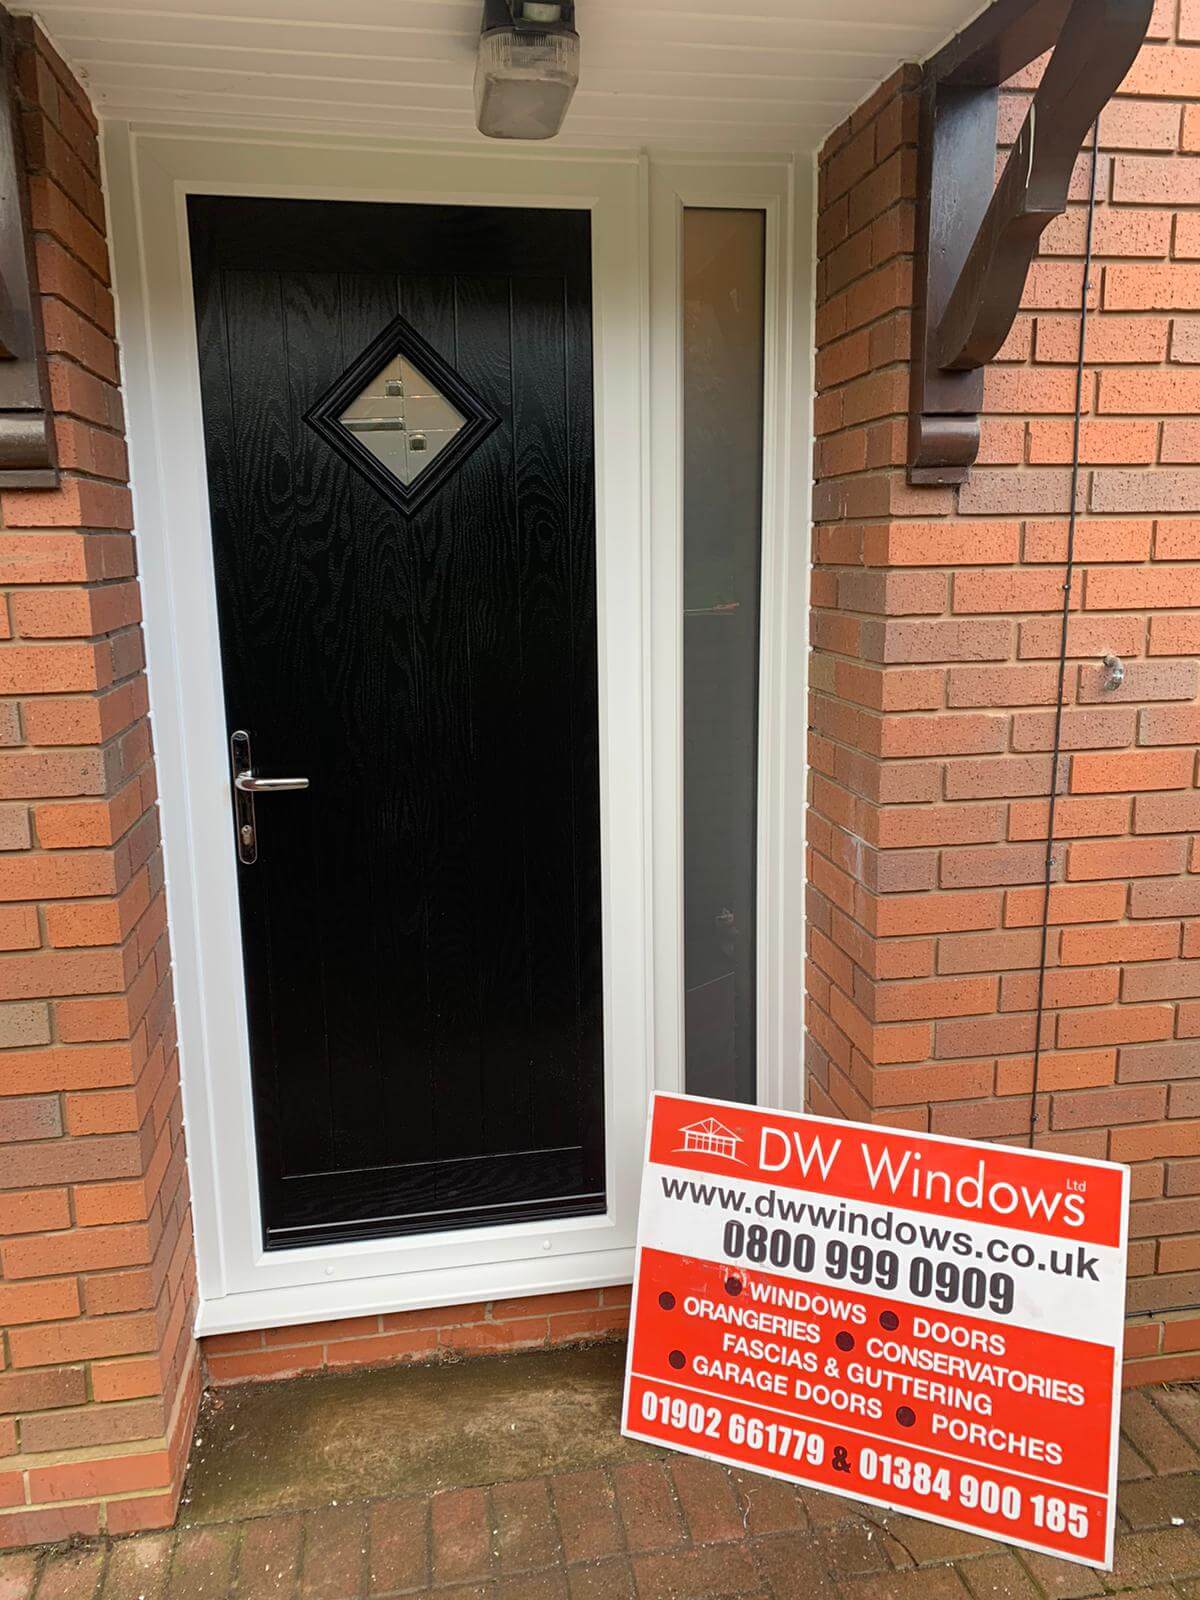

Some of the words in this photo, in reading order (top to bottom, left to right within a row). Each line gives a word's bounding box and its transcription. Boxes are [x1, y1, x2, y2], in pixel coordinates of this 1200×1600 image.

[758, 1126, 841, 1182] DW
[862, 1141, 1086, 1227] Windows
[1066, 1178, 1087, 1193] Ltd
[661, 1176, 1100, 1282] www.dwwindows.co.uk
[723, 1219, 814, 1273] 0800
[825, 1239, 899, 1290] 999
[909, 1256, 1015, 1315] 0909
[683, 1297, 820, 1344] ORANGERIES
[866, 1338, 1085, 1406] CONSERVATORIES
[749, 1282, 867, 1324] WINDOWS
[913, 1317, 1006, 1355] DOORS
[693, 1356, 788, 1396] GARAGE
[795, 1380, 883, 1419] DOORS
[932, 1416, 1063, 1465] PORCHES
[723, 1334, 818, 1372] FASCIAS
[825, 1358, 839, 1378] &
[847, 1363, 993, 1416] GUTTERING
[641, 1391, 720, 1439] 01902
[729, 1414, 825, 1466] 661779
[832, 1446, 852, 1473] &
[859, 1448, 951, 1502] 01384
[959, 1475, 1021, 1521] 900
[1030, 1495, 1089, 1539] 185
